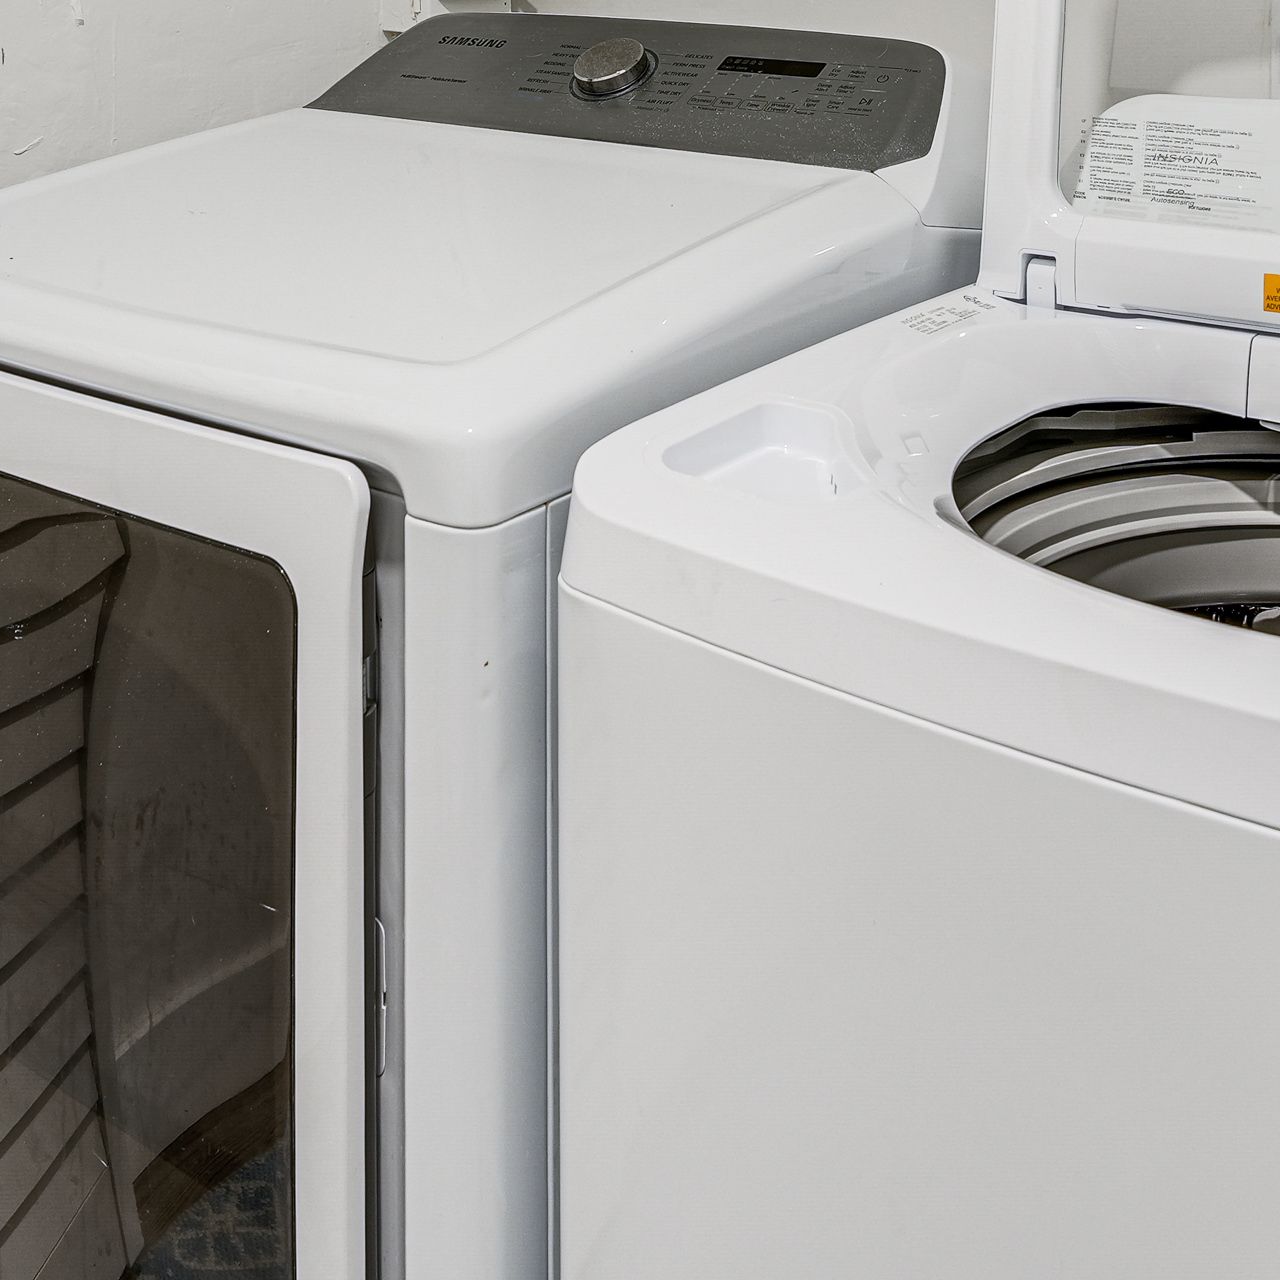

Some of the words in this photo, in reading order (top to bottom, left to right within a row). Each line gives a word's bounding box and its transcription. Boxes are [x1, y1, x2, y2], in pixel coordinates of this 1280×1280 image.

[438, 35, 508, 49] SAMSUNG
[1153, 153, 1218, 166] INSIGNIA
[1151, 197, 1195, 207] Autosensing
